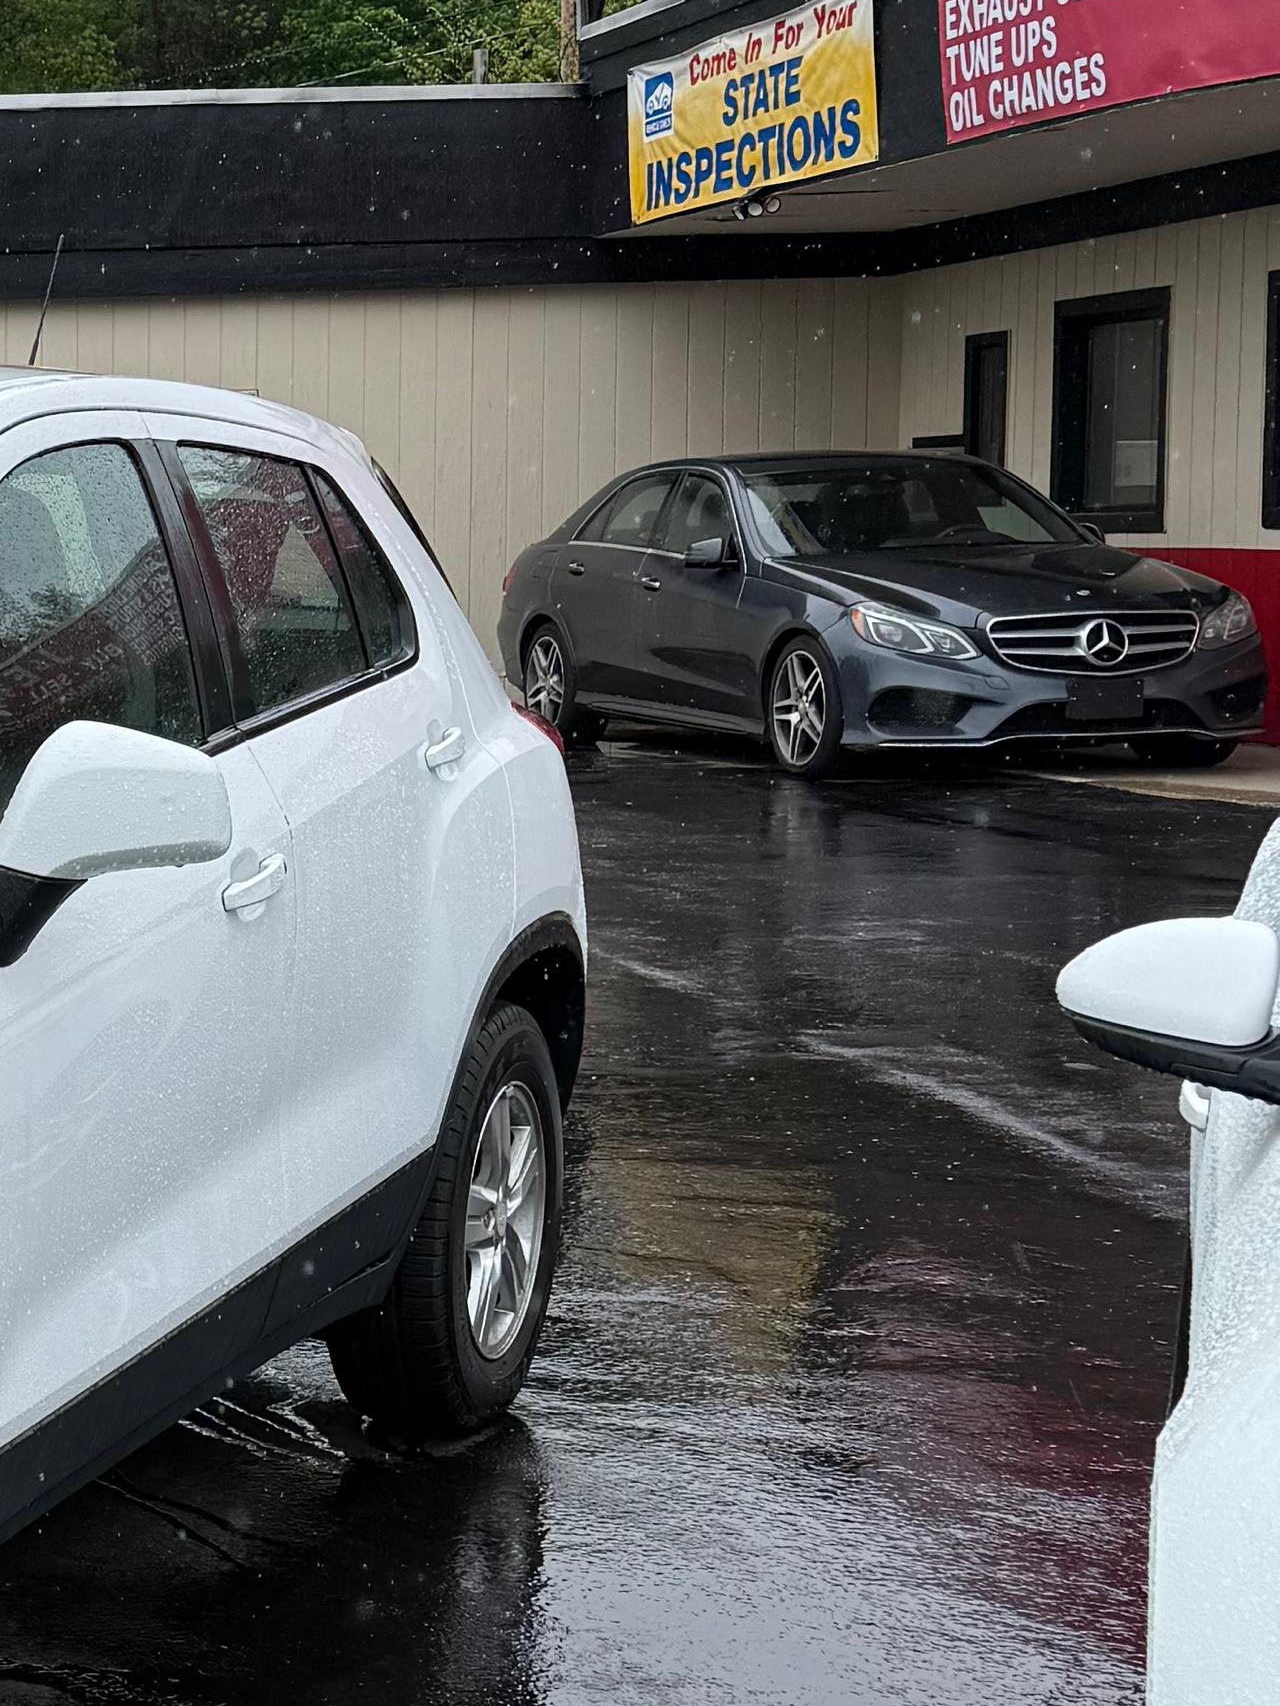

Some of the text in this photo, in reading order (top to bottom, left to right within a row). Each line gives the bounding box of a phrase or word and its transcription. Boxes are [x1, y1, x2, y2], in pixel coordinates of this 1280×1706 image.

[689, 0, 857, 86] Come In For Your
[946, 16, 1056, 86] TUNE UPS
[723, 56, 803, 127] STATE
[950, 53, 1106, 132] OIL CHANGES
[646, 99, 861, 212] INSPECTIONS
